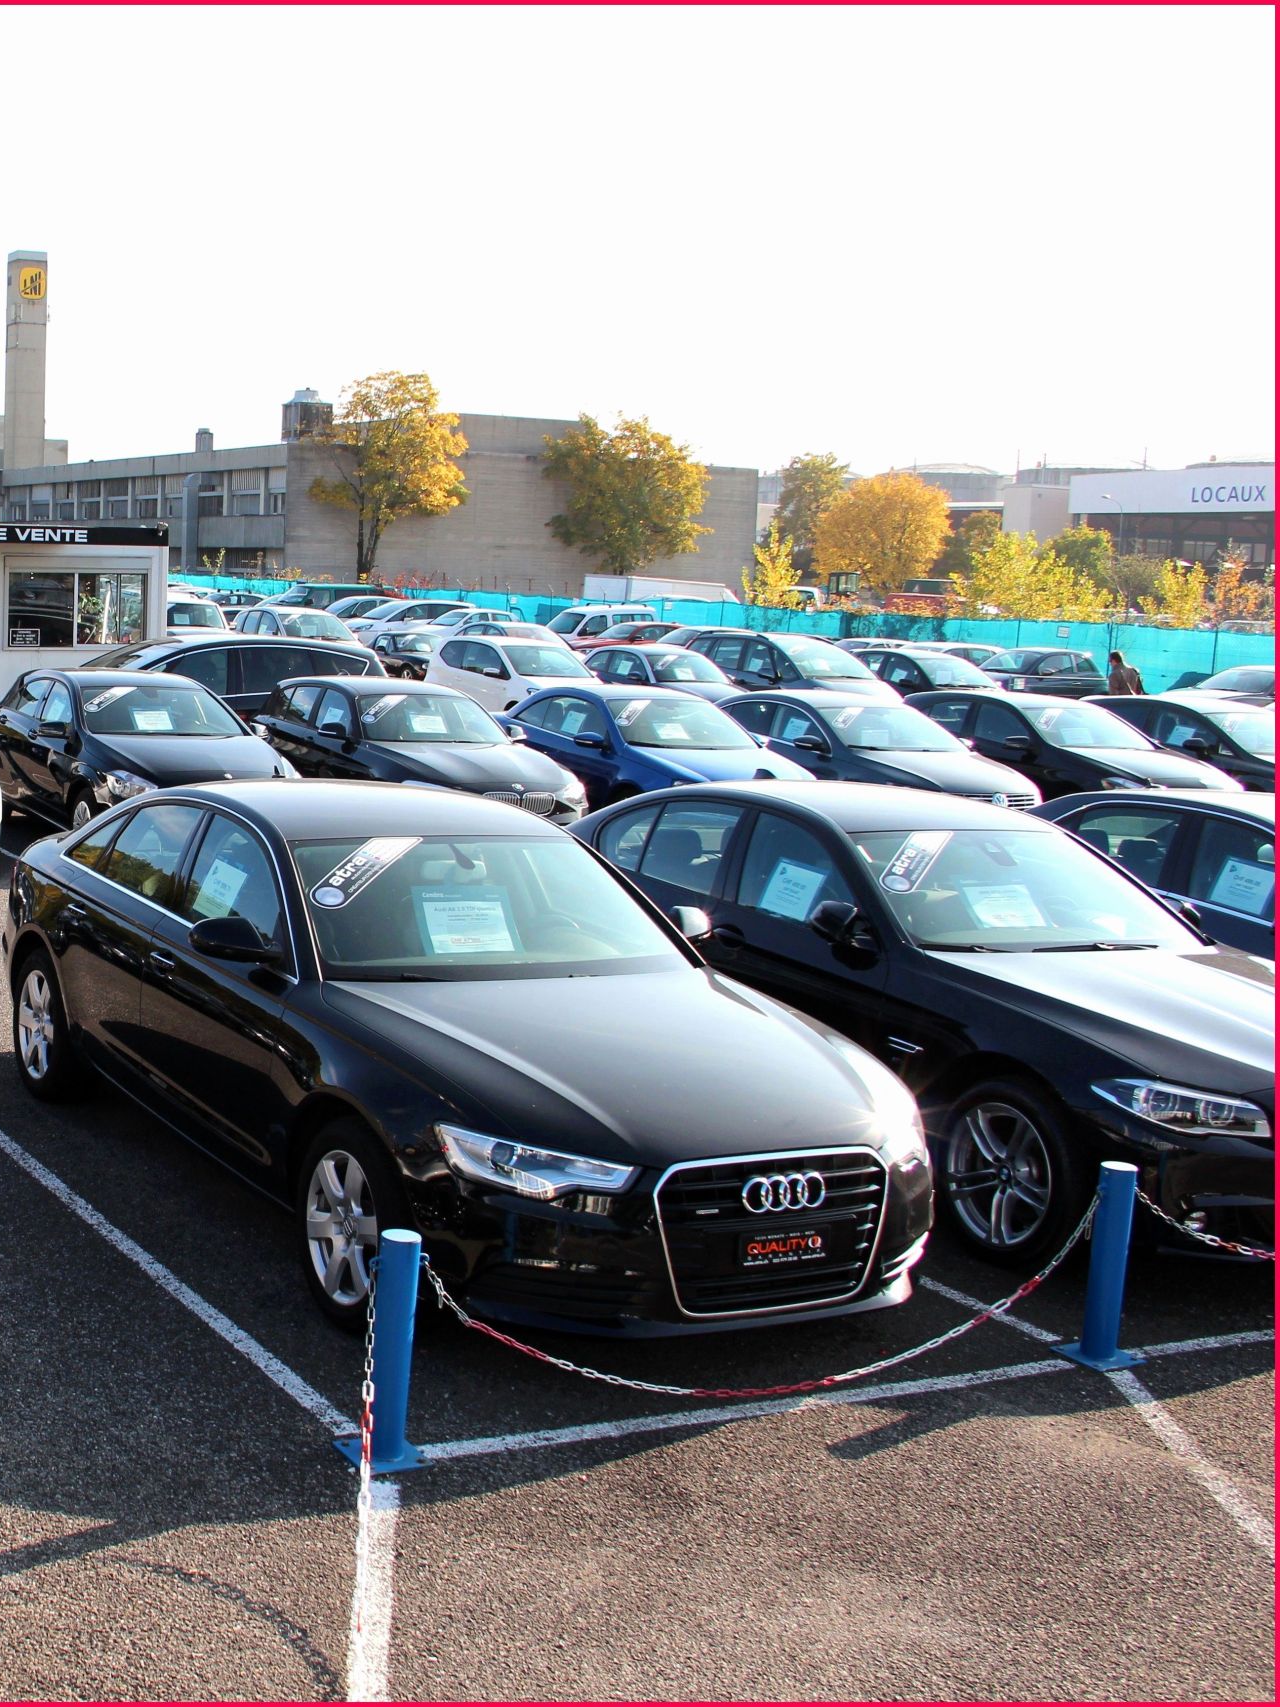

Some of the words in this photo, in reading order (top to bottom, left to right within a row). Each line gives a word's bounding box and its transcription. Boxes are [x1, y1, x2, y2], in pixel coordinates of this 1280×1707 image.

[1191, 485, 1266, 503] LOCAUX
[14, 528, 88, 543] VENTE
[891, 848, 917, 875] atra
[329, 856, 368, 887] atra
[747, 1238, 807, 1254] QUALITY
